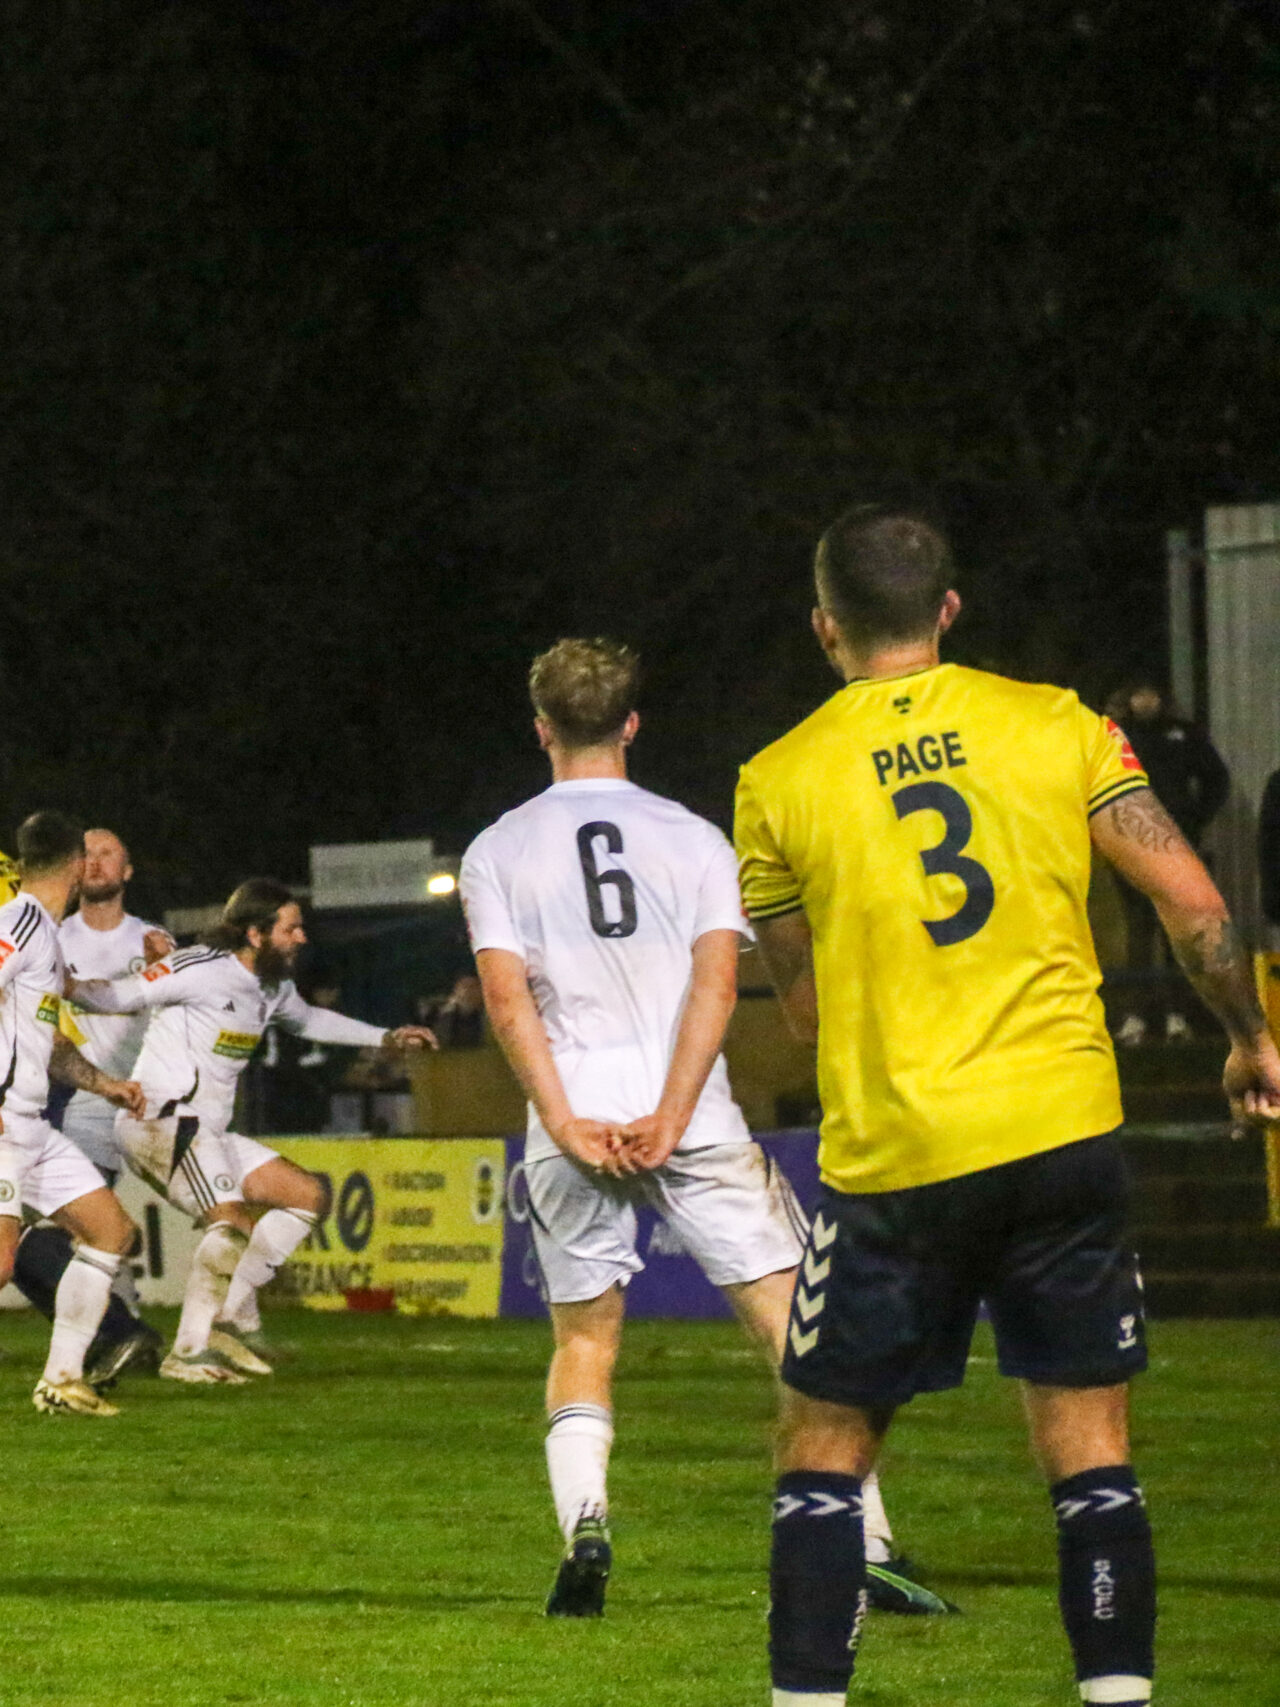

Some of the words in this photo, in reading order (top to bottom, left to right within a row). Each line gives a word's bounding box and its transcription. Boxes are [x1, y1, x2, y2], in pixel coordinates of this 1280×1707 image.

[871, 731, 967, 786] PAGE
[577, 820, 637, 938] 6
[891, 780, 995, 947] 3
[1092, 1559, 1114, 1620] SACFC
